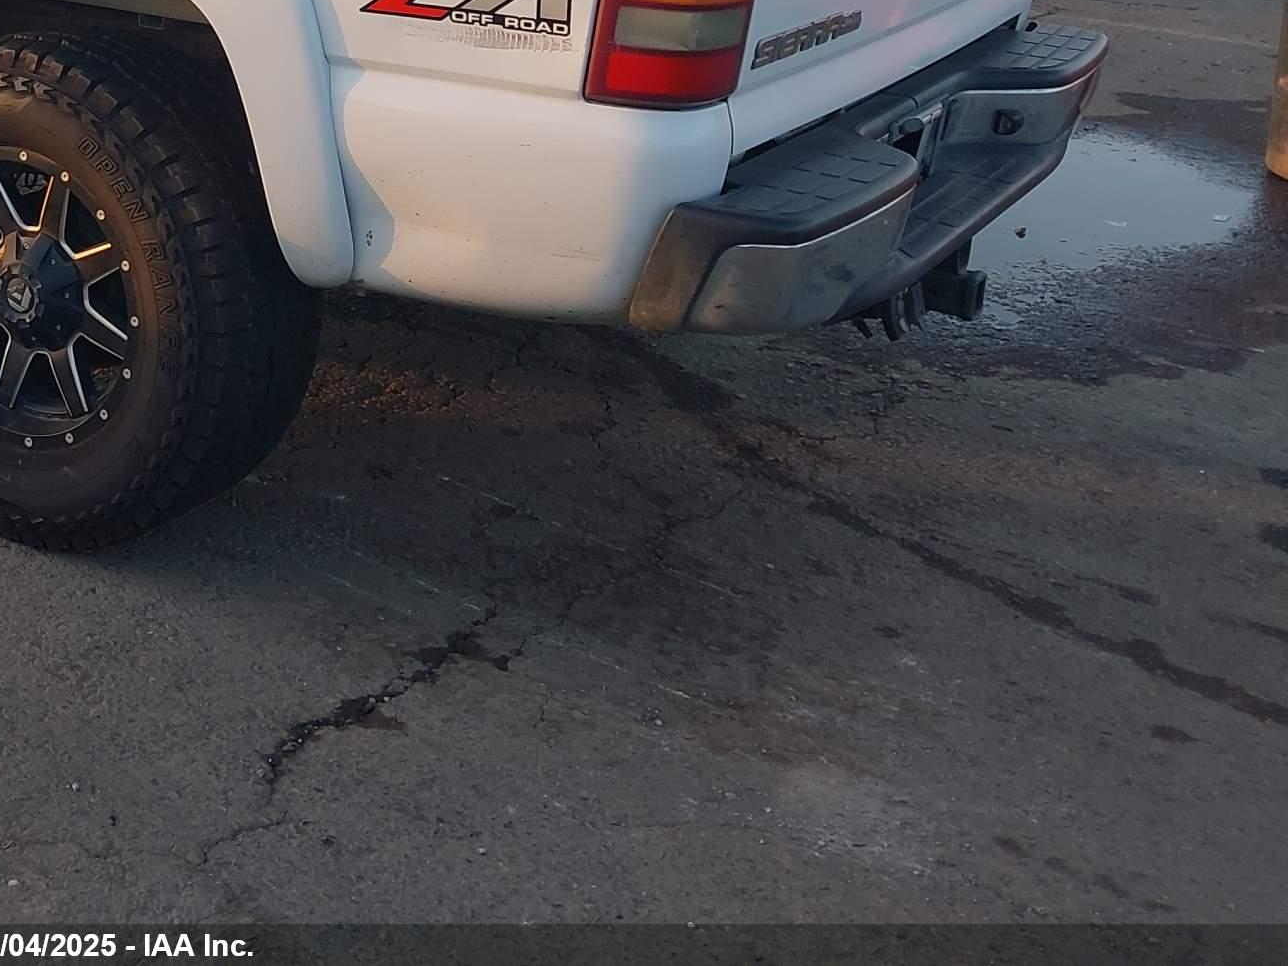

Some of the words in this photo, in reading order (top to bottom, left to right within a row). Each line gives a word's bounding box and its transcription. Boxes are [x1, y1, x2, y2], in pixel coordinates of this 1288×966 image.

[450, 10, 495, 26] OFF
[504, 18, 570, 36] ROAD
[750, 10, 862, 71] SIERRA
[76, 135, 150, 224] OPEN
